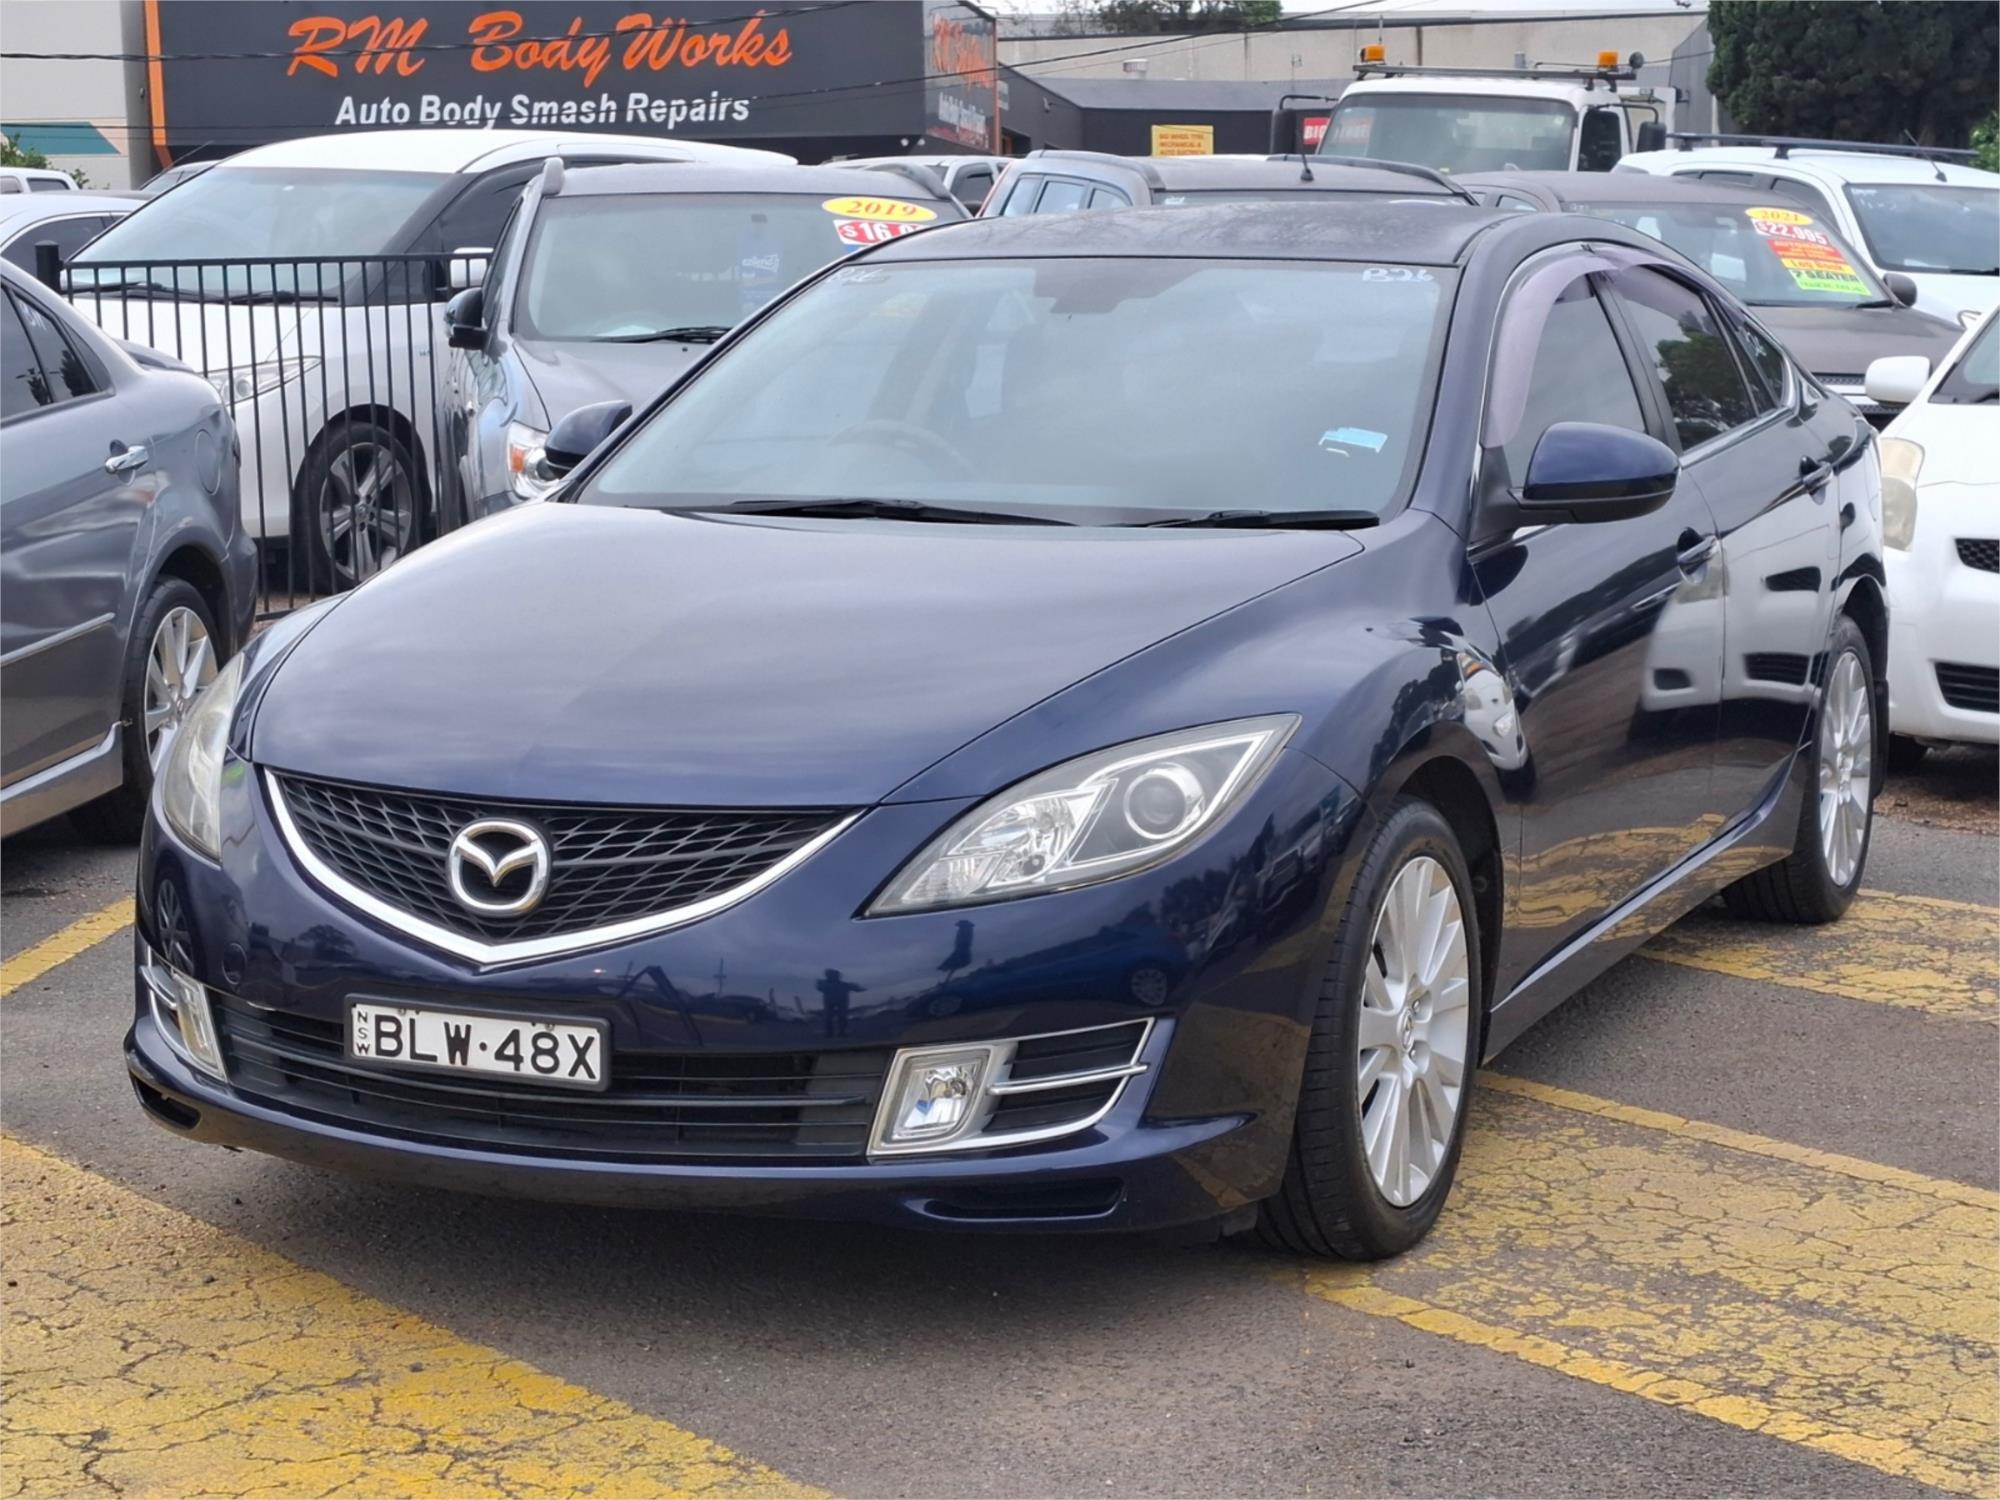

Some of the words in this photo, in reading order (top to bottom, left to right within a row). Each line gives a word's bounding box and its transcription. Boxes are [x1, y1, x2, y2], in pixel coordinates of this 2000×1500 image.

[287, 15, 429, 78] RM
[334, 96, 411, 125] Auto
[419, 94, 502, 130] Body
[510, 93, 617, 125] Smash
[626, 90, 750, 130] Repairs
[847, 200, 918, 217] 2019
[1760, 210, 1799, 222] 2021
